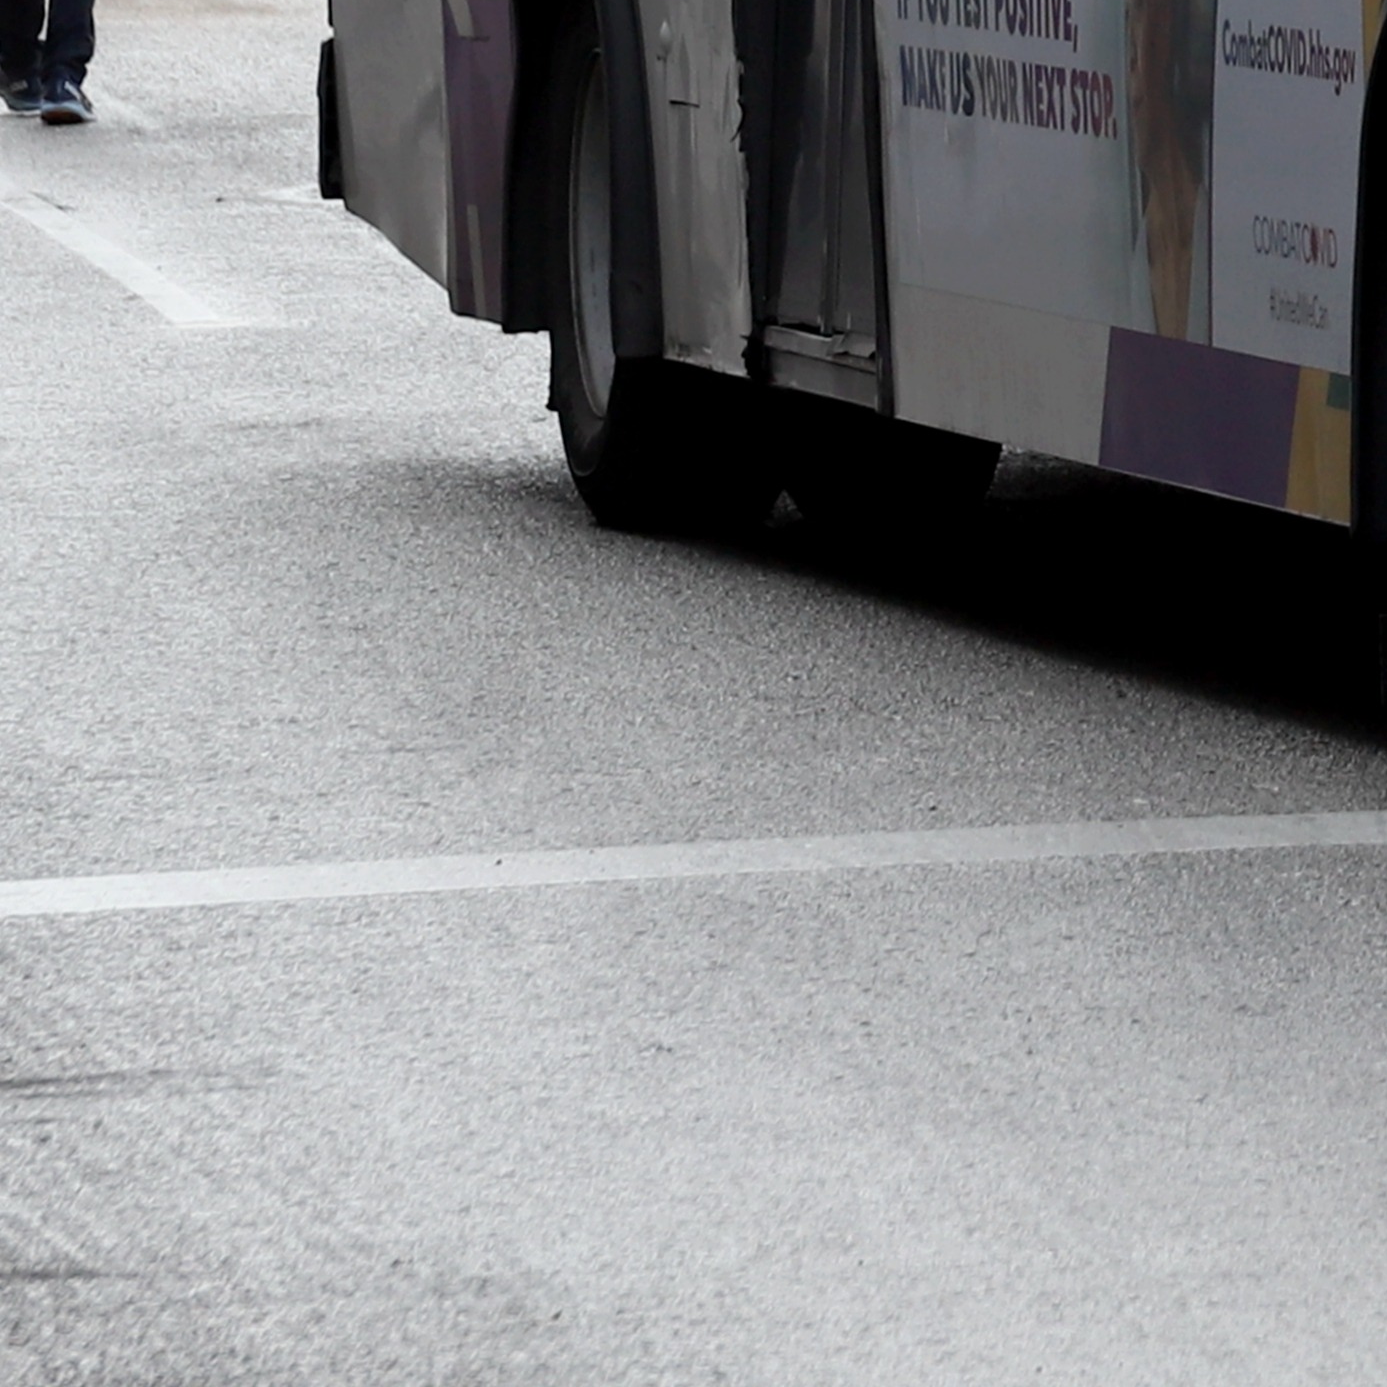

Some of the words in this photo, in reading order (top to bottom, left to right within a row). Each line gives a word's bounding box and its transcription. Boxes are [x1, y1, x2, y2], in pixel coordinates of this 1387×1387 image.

[899, 44, 946, 113] MAKE
[949, 50, 975, 117] US
[974, 53, 1020, 124] YOUR
[1022, 61, 1066, 132] NEXT
[1071, 67, 1118, 141] STOP.
[1221, 19, 1357, 96] CombatCOVID.hhs.gov
